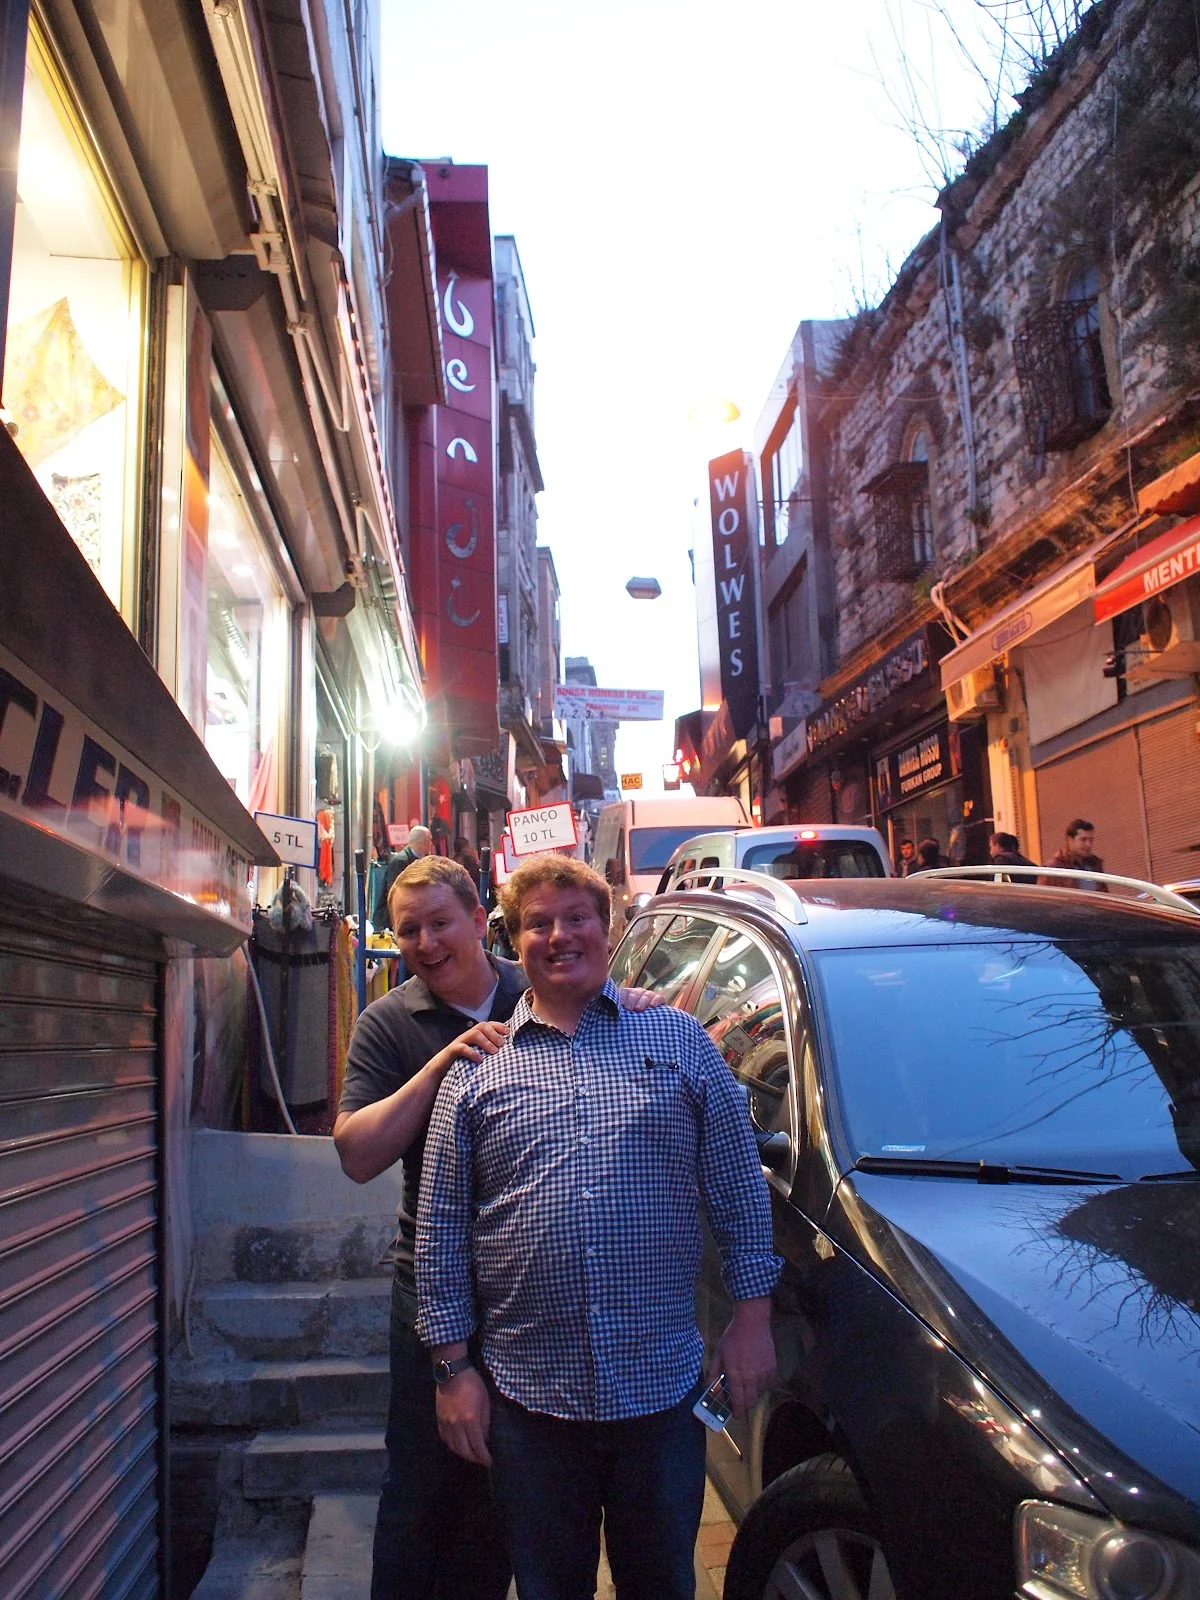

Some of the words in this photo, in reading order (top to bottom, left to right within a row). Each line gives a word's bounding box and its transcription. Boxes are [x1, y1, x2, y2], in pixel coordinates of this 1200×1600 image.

[714, 471, 745, 677] WOLWES
[923, 763, 942, 782] GROUP
[513, 809, 558, 827] PANÇO
[273, 832, 281, 844] 5
[285, 833, 303, 848] TL
[523, 831, 538, 844] 10
[541, 829, 556, 840] TL
